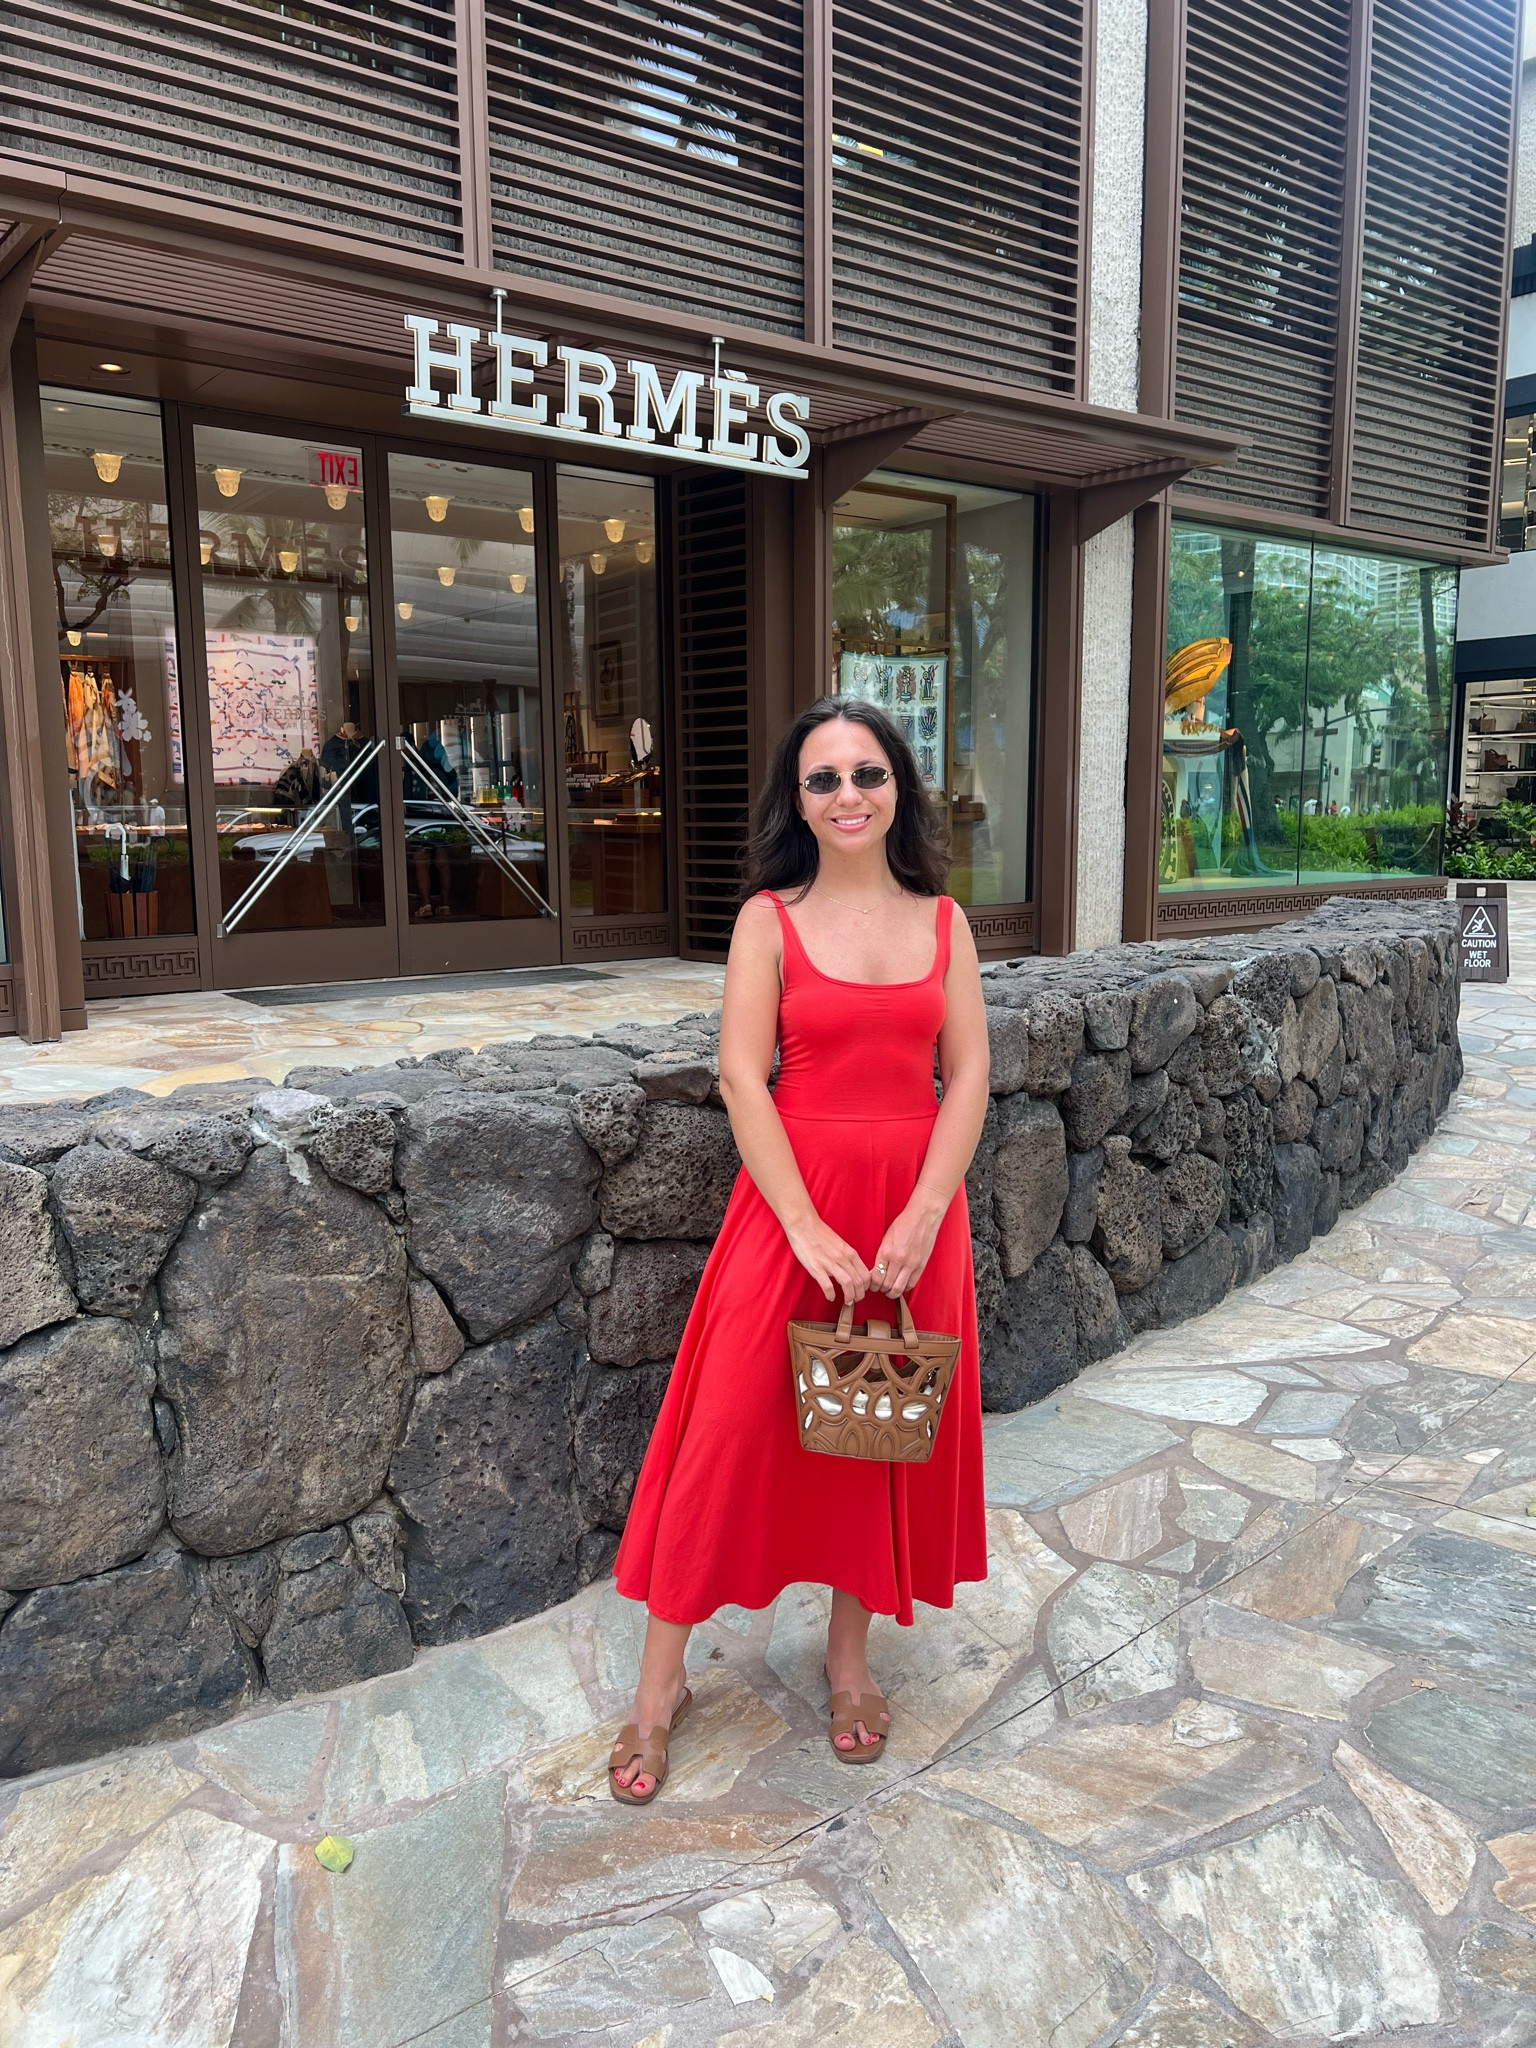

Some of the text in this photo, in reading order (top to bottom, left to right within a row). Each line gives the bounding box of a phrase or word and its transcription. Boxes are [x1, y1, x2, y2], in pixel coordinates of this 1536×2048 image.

[404, 314, 811, 468] HERMÈS
[1461, 939, 1497, 948] CAUTION
[1469, 950, 1488, 959] WET
[1464, 959, 1491, 968] FLOOR
